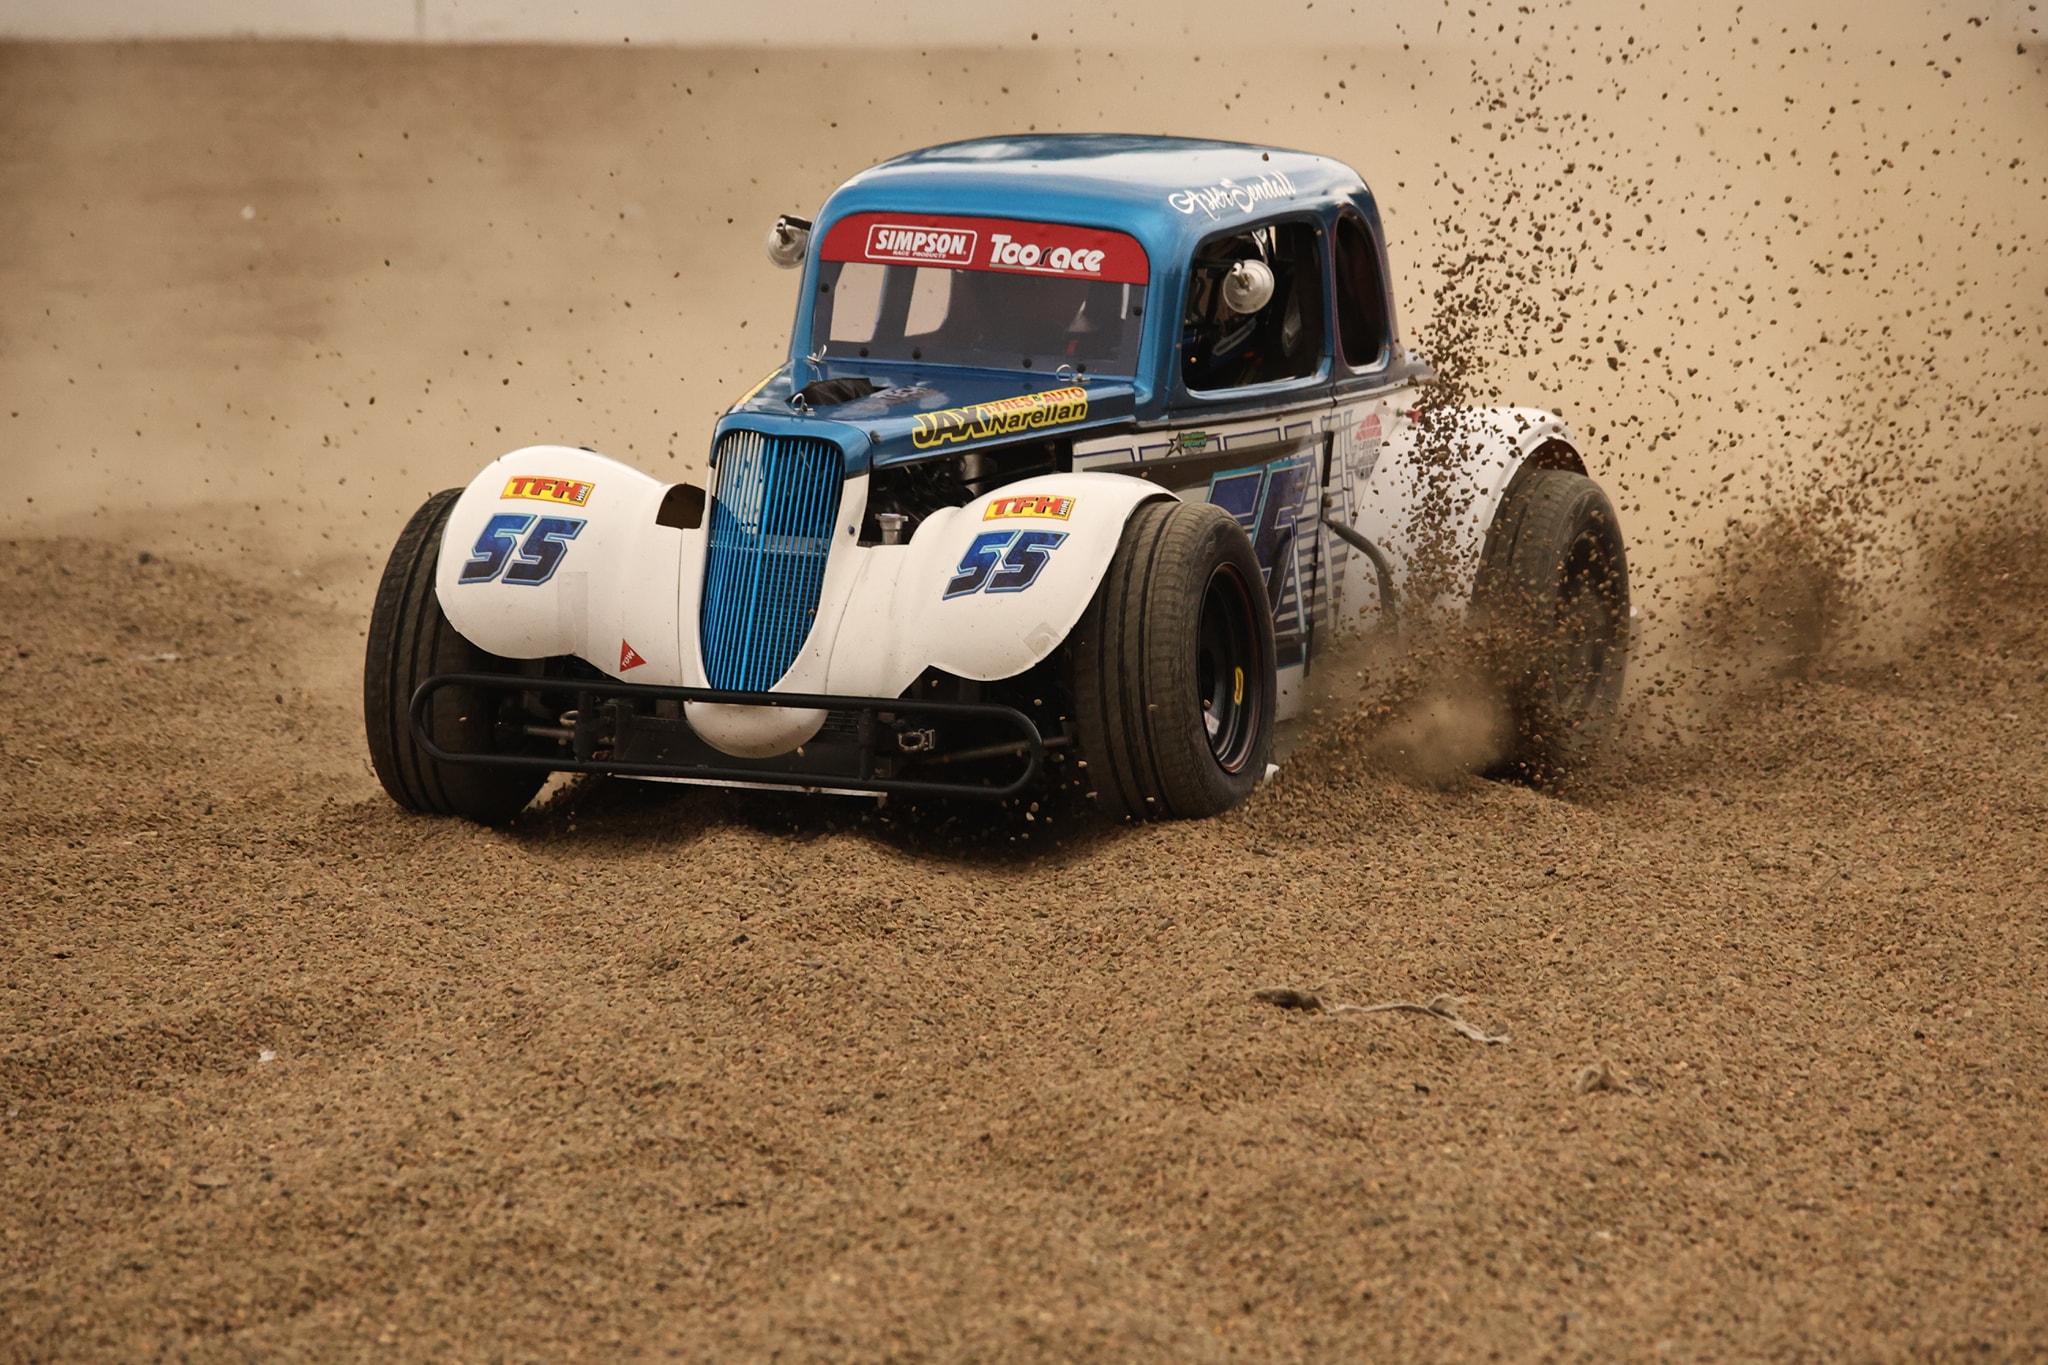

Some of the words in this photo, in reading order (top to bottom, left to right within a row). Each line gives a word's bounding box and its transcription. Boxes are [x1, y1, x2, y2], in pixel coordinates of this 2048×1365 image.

[875, 229, 967, 255] SIMPSON
[892, 249, 910, 257] RACE
[912, 250, 947, 259] PRODUCTS
[914, 406, 985, 444] JAX
[980, 396, 1034, 414] TYRES
[1042, 387, 1085, 404] AUTO
[989, 402, 1086, 432] Narellan
[511, 477, 582, 501] TFH
[993, 496, 1064, 515] TFH
[458, 512, 588, 586] 55
[942, 529, 1071, 601] 55
[621, 650, 635, 667] TOW
